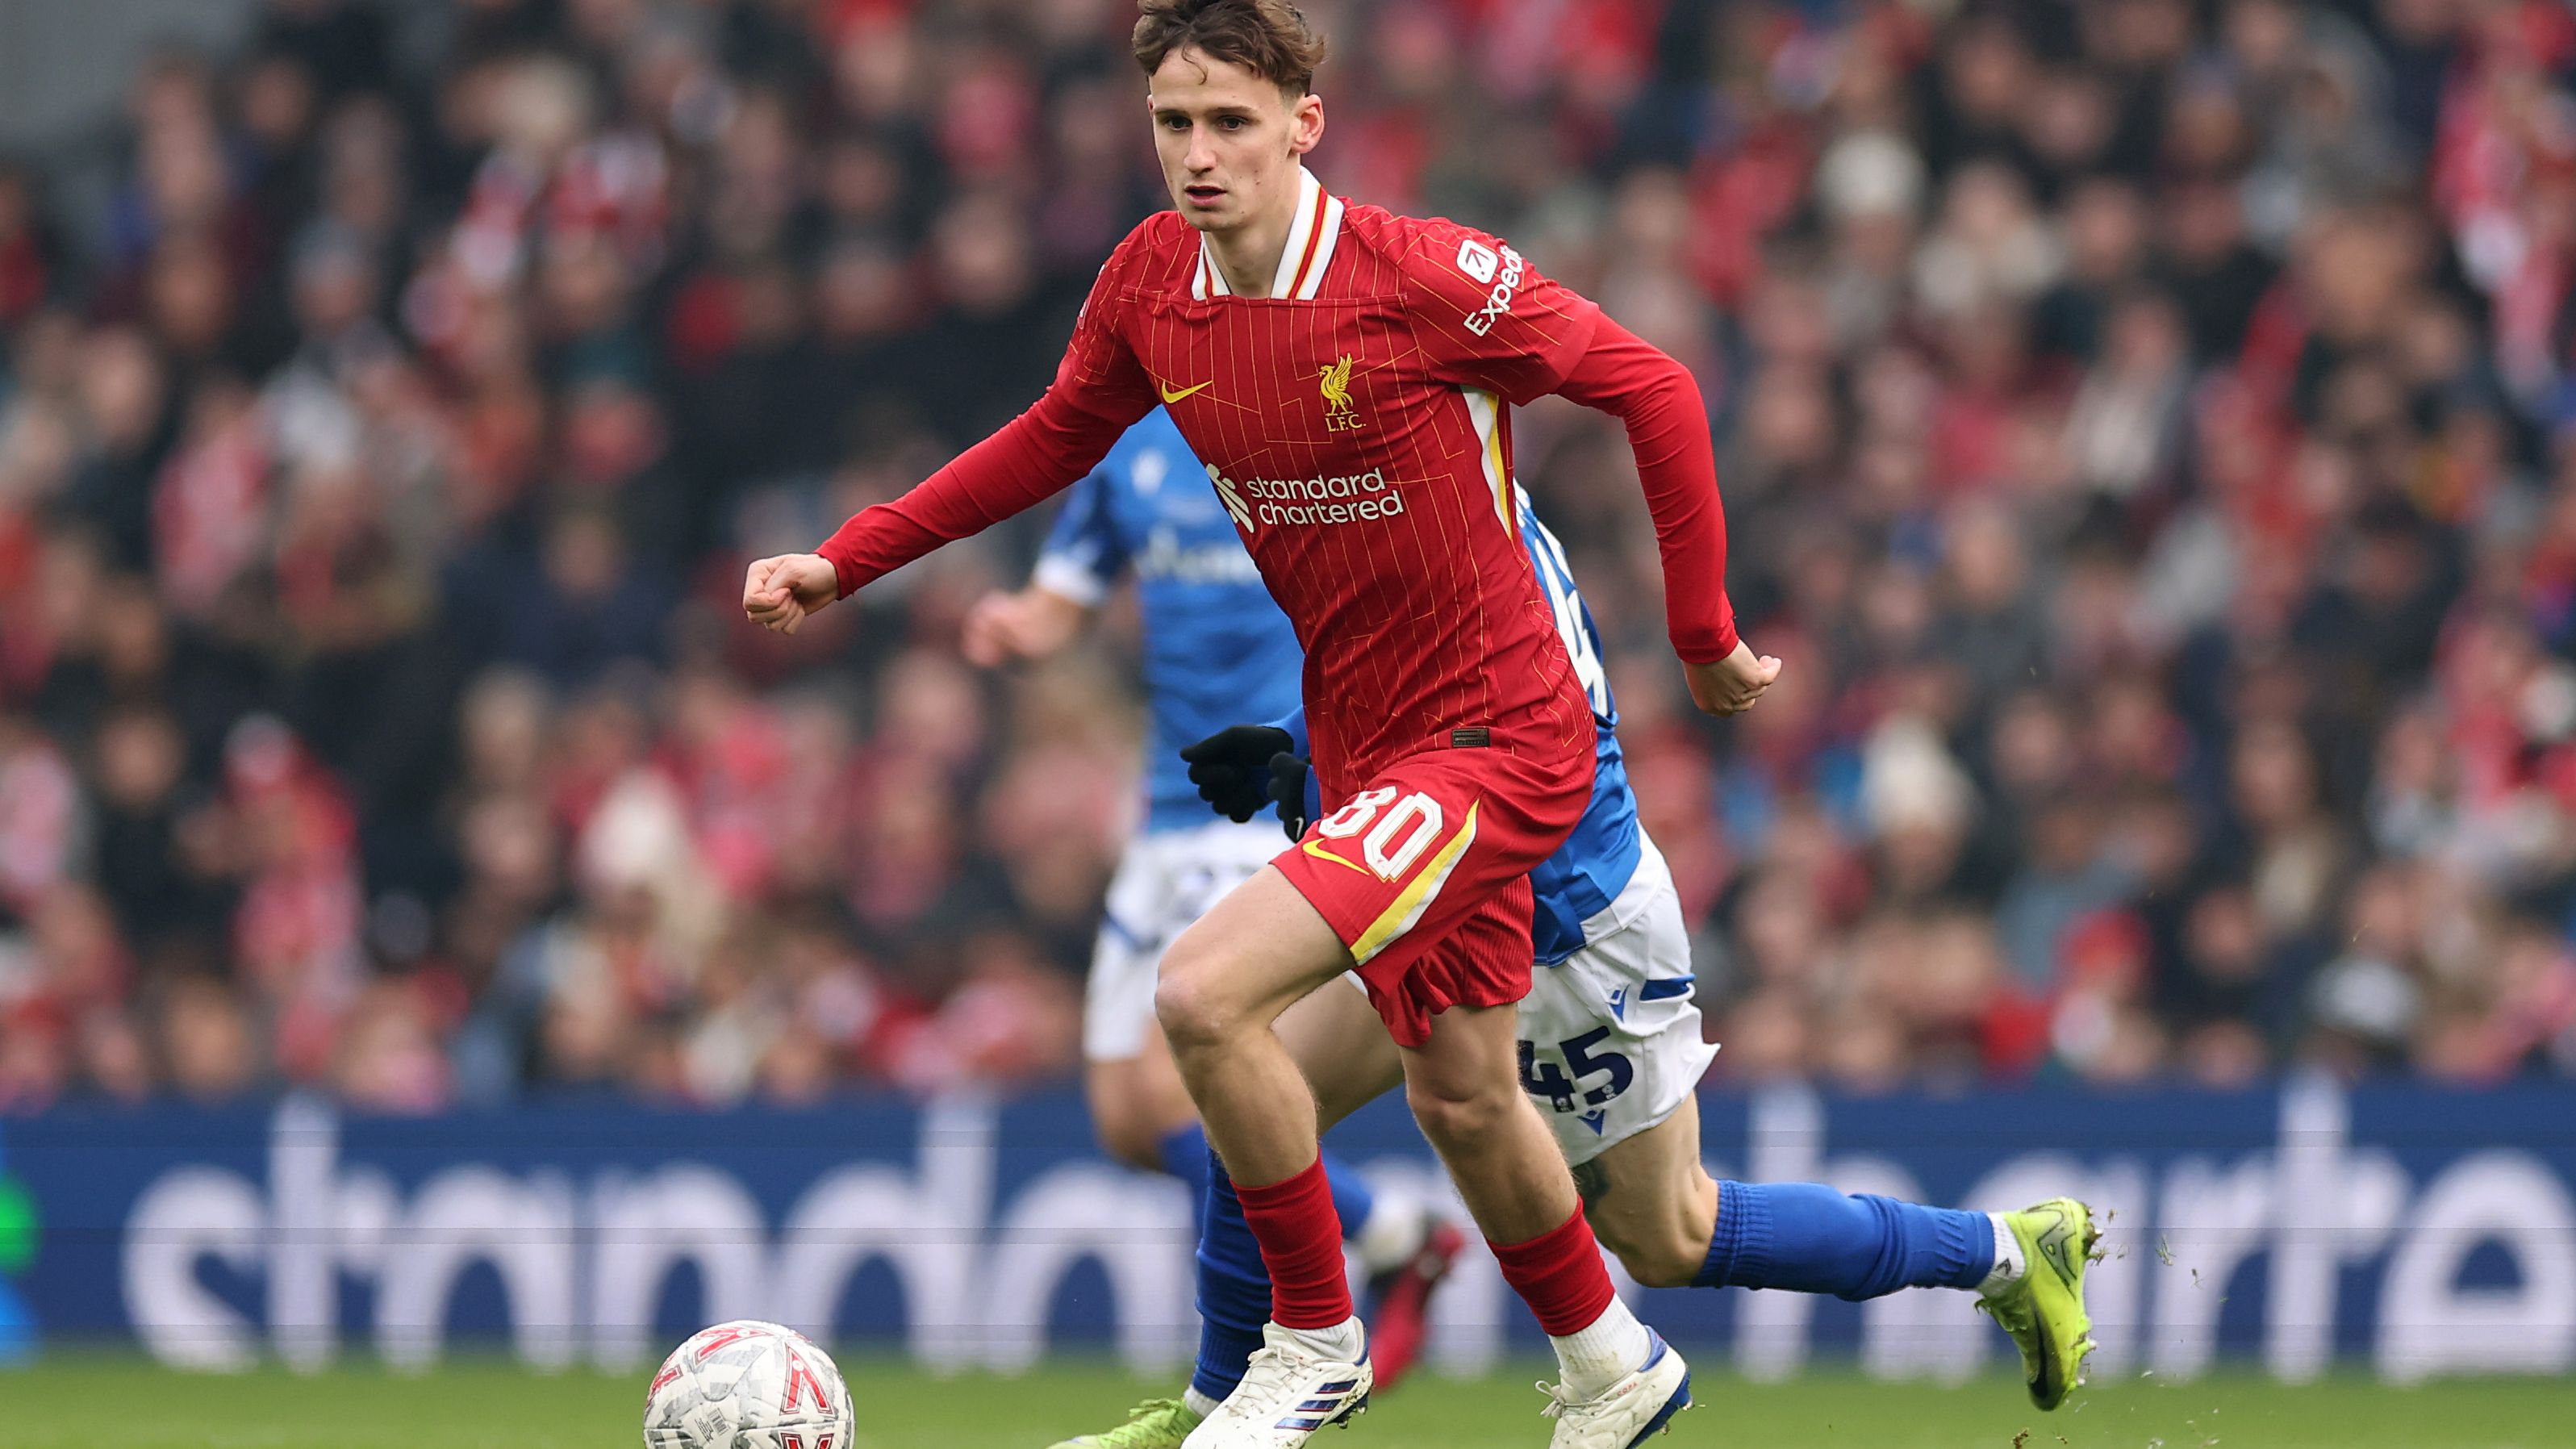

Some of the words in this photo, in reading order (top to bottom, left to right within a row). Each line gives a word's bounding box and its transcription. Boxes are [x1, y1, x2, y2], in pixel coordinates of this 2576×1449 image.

[1326, 415, 1366, 432] L.F.C.
[1246, 467, 1385, 499] standard
[1259, 490, 1404, 525] chartered
[1318, 786, 1443, 883] 80
[1517, 1025, 1633, 1113] 45
[121, 1085, 1505, 1373] standa
[1597, 1073, 2576, 1388] harte
